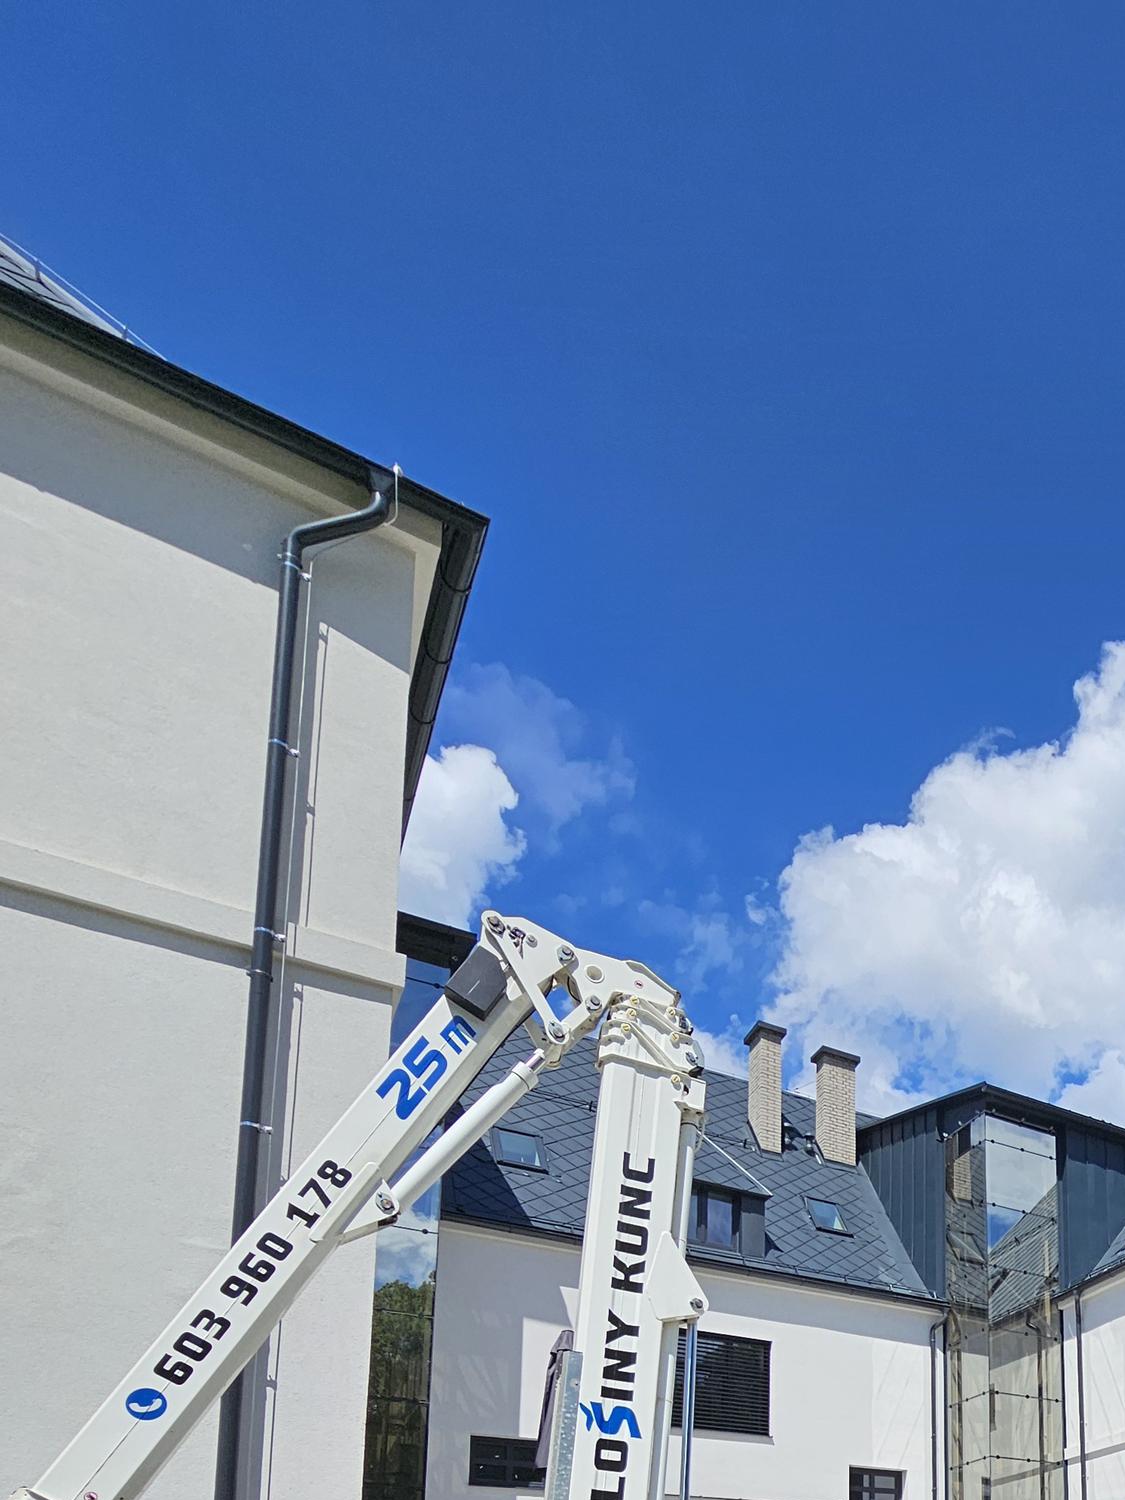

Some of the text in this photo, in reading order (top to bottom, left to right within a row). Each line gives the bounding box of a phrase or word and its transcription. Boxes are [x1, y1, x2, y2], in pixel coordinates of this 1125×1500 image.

[154, 1160, 353, 1386] 603 960 178
[611, 1152, 656, 1294] KUNC
